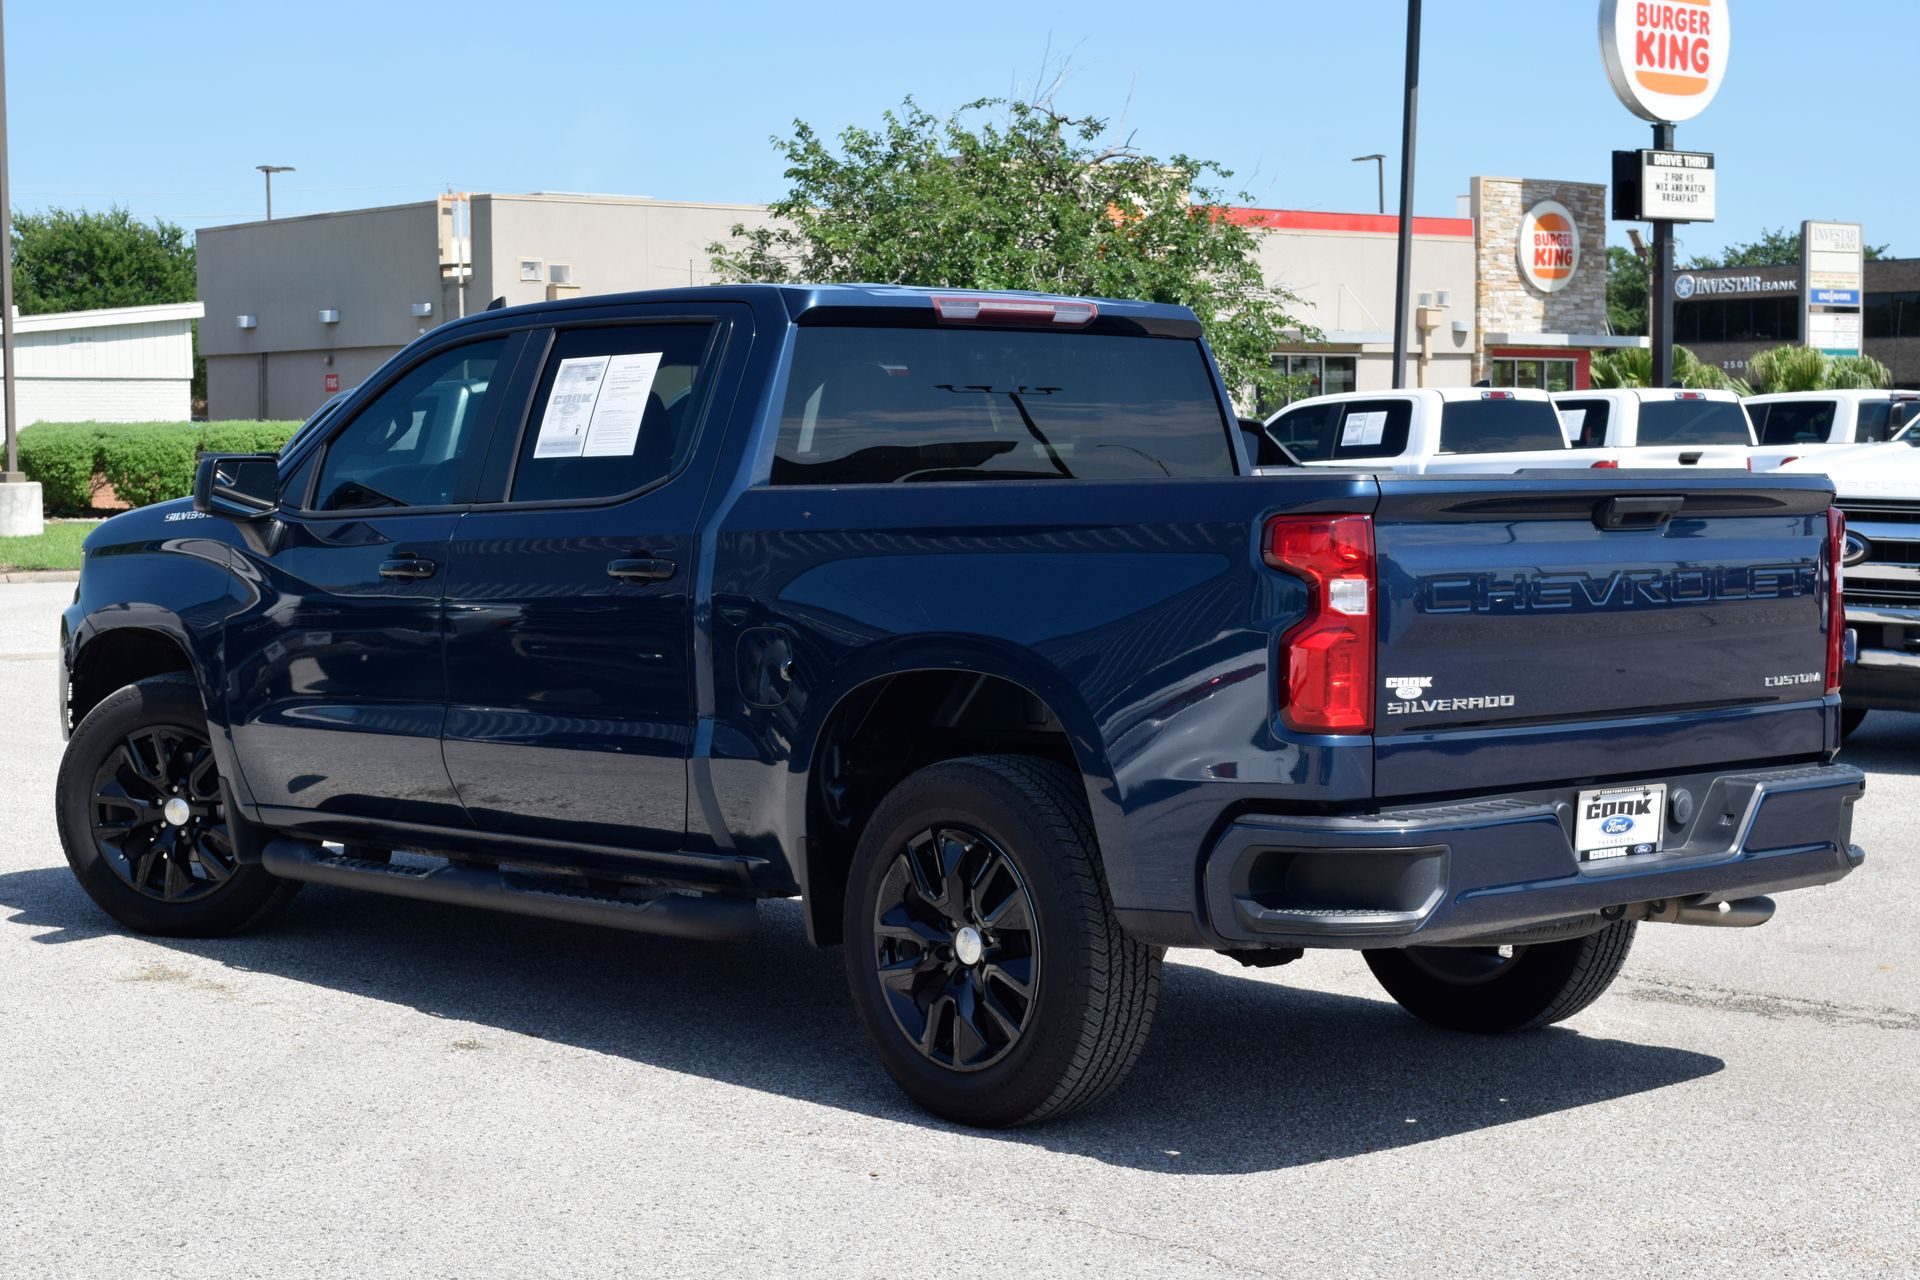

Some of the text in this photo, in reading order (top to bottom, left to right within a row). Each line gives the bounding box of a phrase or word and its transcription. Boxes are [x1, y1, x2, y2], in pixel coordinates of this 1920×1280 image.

[1636, 2, 1710, 35] BURGER
[1635, 30, 1710, 73] KING
[1654, 153, 1708, 168] DRIVE THRU
[1664, 172, 1668, 181] 2
[1671, 172, 1683, 182] FOR
[1655, 182, 1706, 193] MIX AND MATCH
[1662, 192, 1698, 203] BREAKFAST
[1533, 232, 1573, 247] BURGER
[1814, 227, 1857, 242] INVESTAR
[1834, 242, 1857, 250] BANK
[1533, 248, 1573, 267] KING
[1695, 276, 1798, 294] INVESTAR BANK
[1723, 361, 1749, 369] 2501
[1425, 564, 1815, 613] CHEVROLET
[1385, 676, 1433, 688] COOK
[1764, 672, 1821, 687] CUSTOM
[1387, 695, 1515, 715] SILVERADO
[1586, 799, 1652, 820] COOK
[1606, 818, 1628, 833] Ford
[1598, 836, 1634, 846] TEXAS CITY
[1589, 846, 1628, 860] COOK
